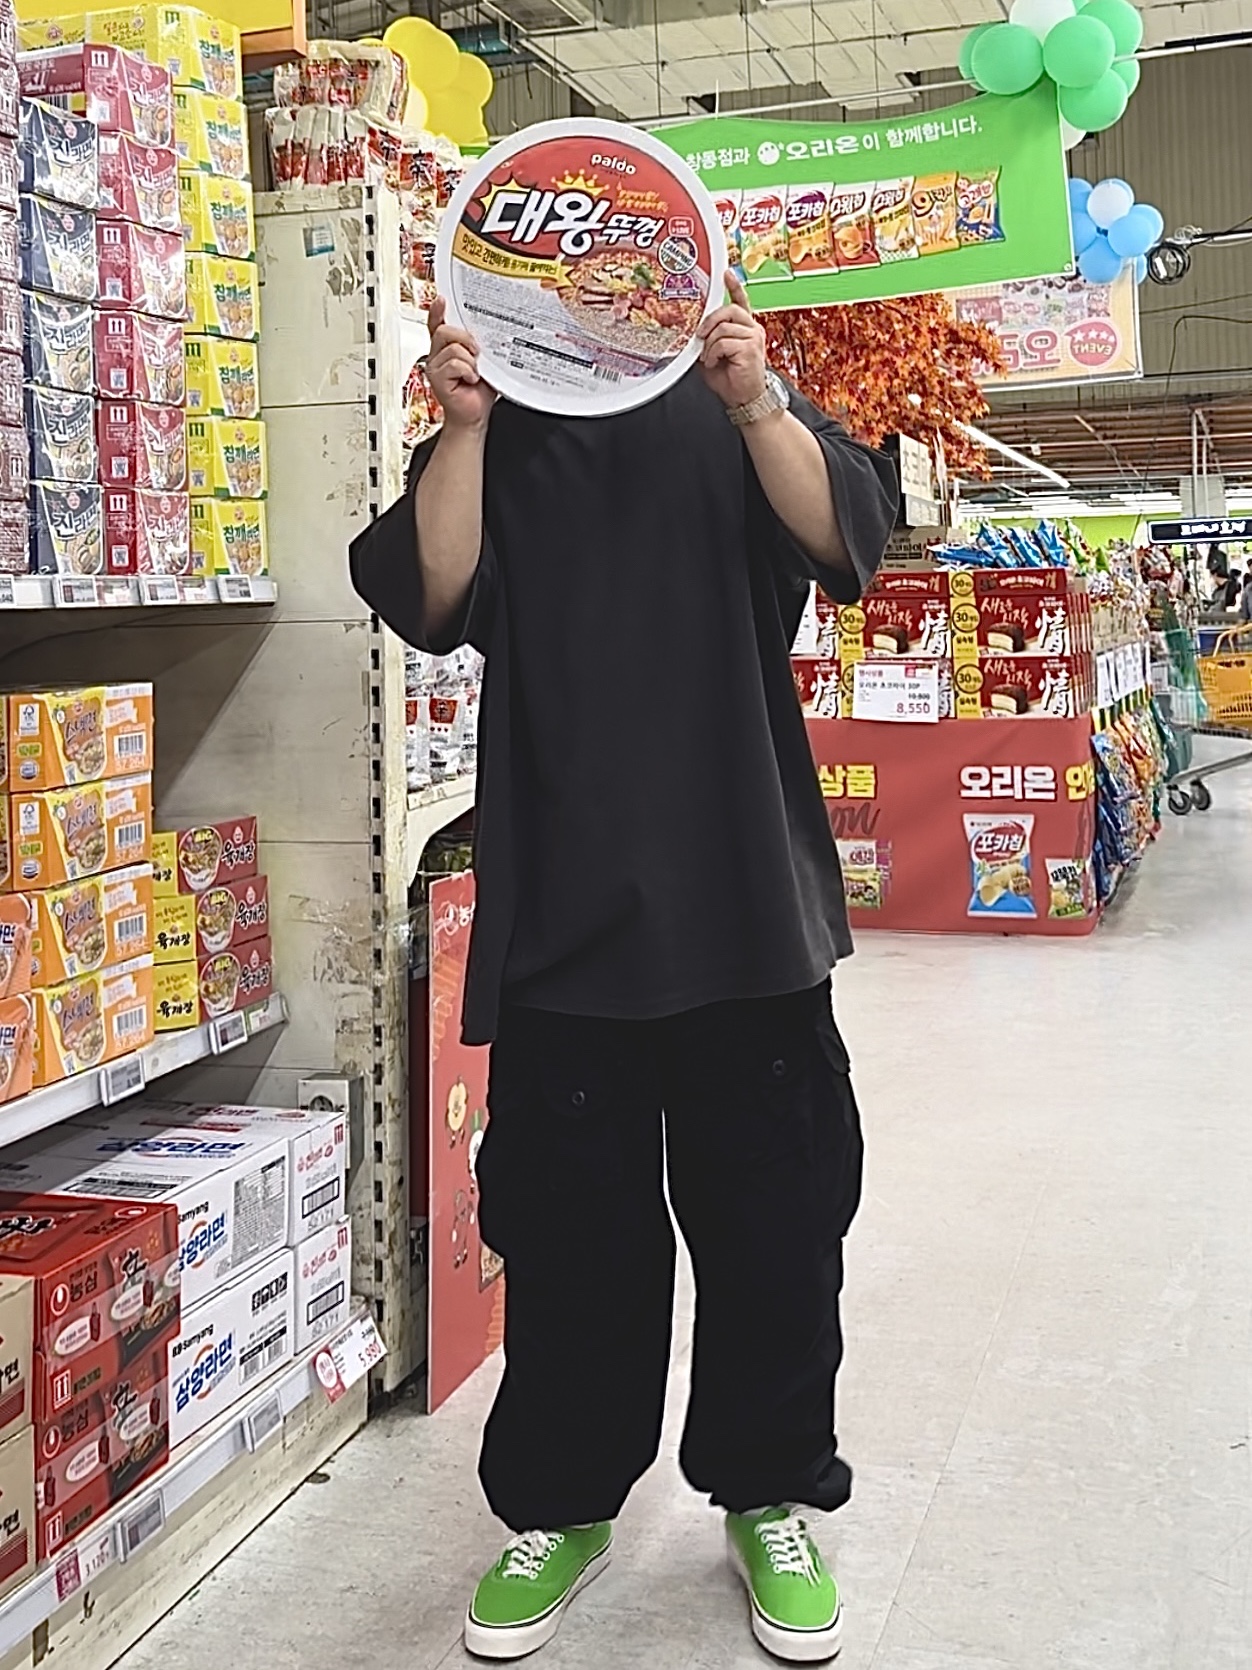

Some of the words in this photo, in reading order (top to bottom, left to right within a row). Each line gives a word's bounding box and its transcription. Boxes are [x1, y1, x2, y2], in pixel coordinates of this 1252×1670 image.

[886, 115, 983, 149] 함께합니다.
[590, 153, 637, 176] paldo
[741, 205, 780, 228] 포카칩
[786, 201, 825, 222] 포카칩
[662, 242, 694, 268] CAMPING
[896, 702, 931, 715] 8,550
[960, 765, 1056, 800] 오리온
[221, 839, 256, 871] 육개장
[975, 832, 1023, 853] 포카칩
[235, 899, 267, 930] 육개장
[155, 931, 191, 950] 육개장
[239, 961, 271, 995] 육개장
[156, 1000, 194, 1019] 육개장
[70, 1270, 98, 1303] 농심
[175, 1332, 233, 1413] 삼양라면
